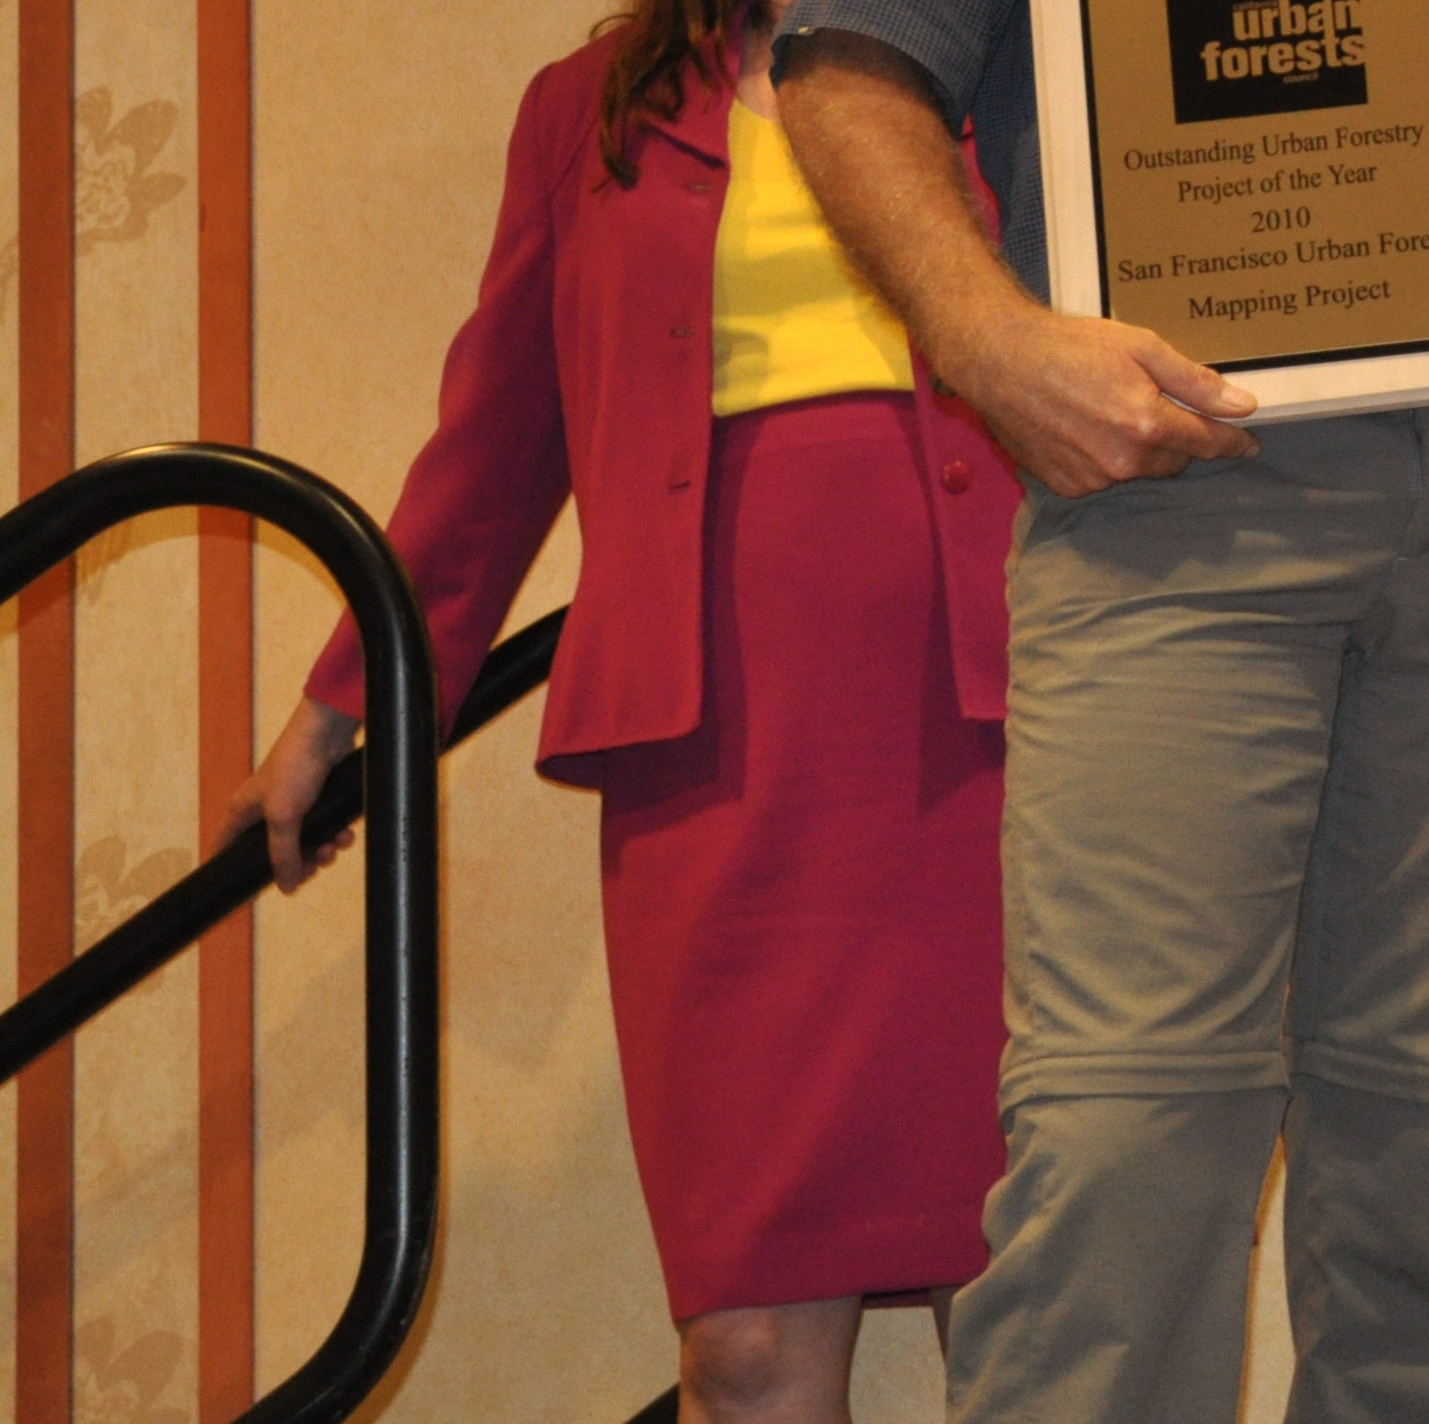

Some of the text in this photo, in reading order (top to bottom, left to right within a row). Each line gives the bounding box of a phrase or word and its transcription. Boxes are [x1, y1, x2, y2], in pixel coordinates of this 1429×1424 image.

[1200, 34, 1366, 82] forests
[1124, 124, 1424, 171] Outstanding Urban Forestry
[1177, 163, 1378, 204] Project of the Year
[1250, 205, 1312, 234] 2010
[1118, 259, 1162, 283] San
[1170, 246, 1288, 278] Francisco
[1295, 238, 1371, 264] Urban
[1189, 279, 1391, 321] Mapping Project
